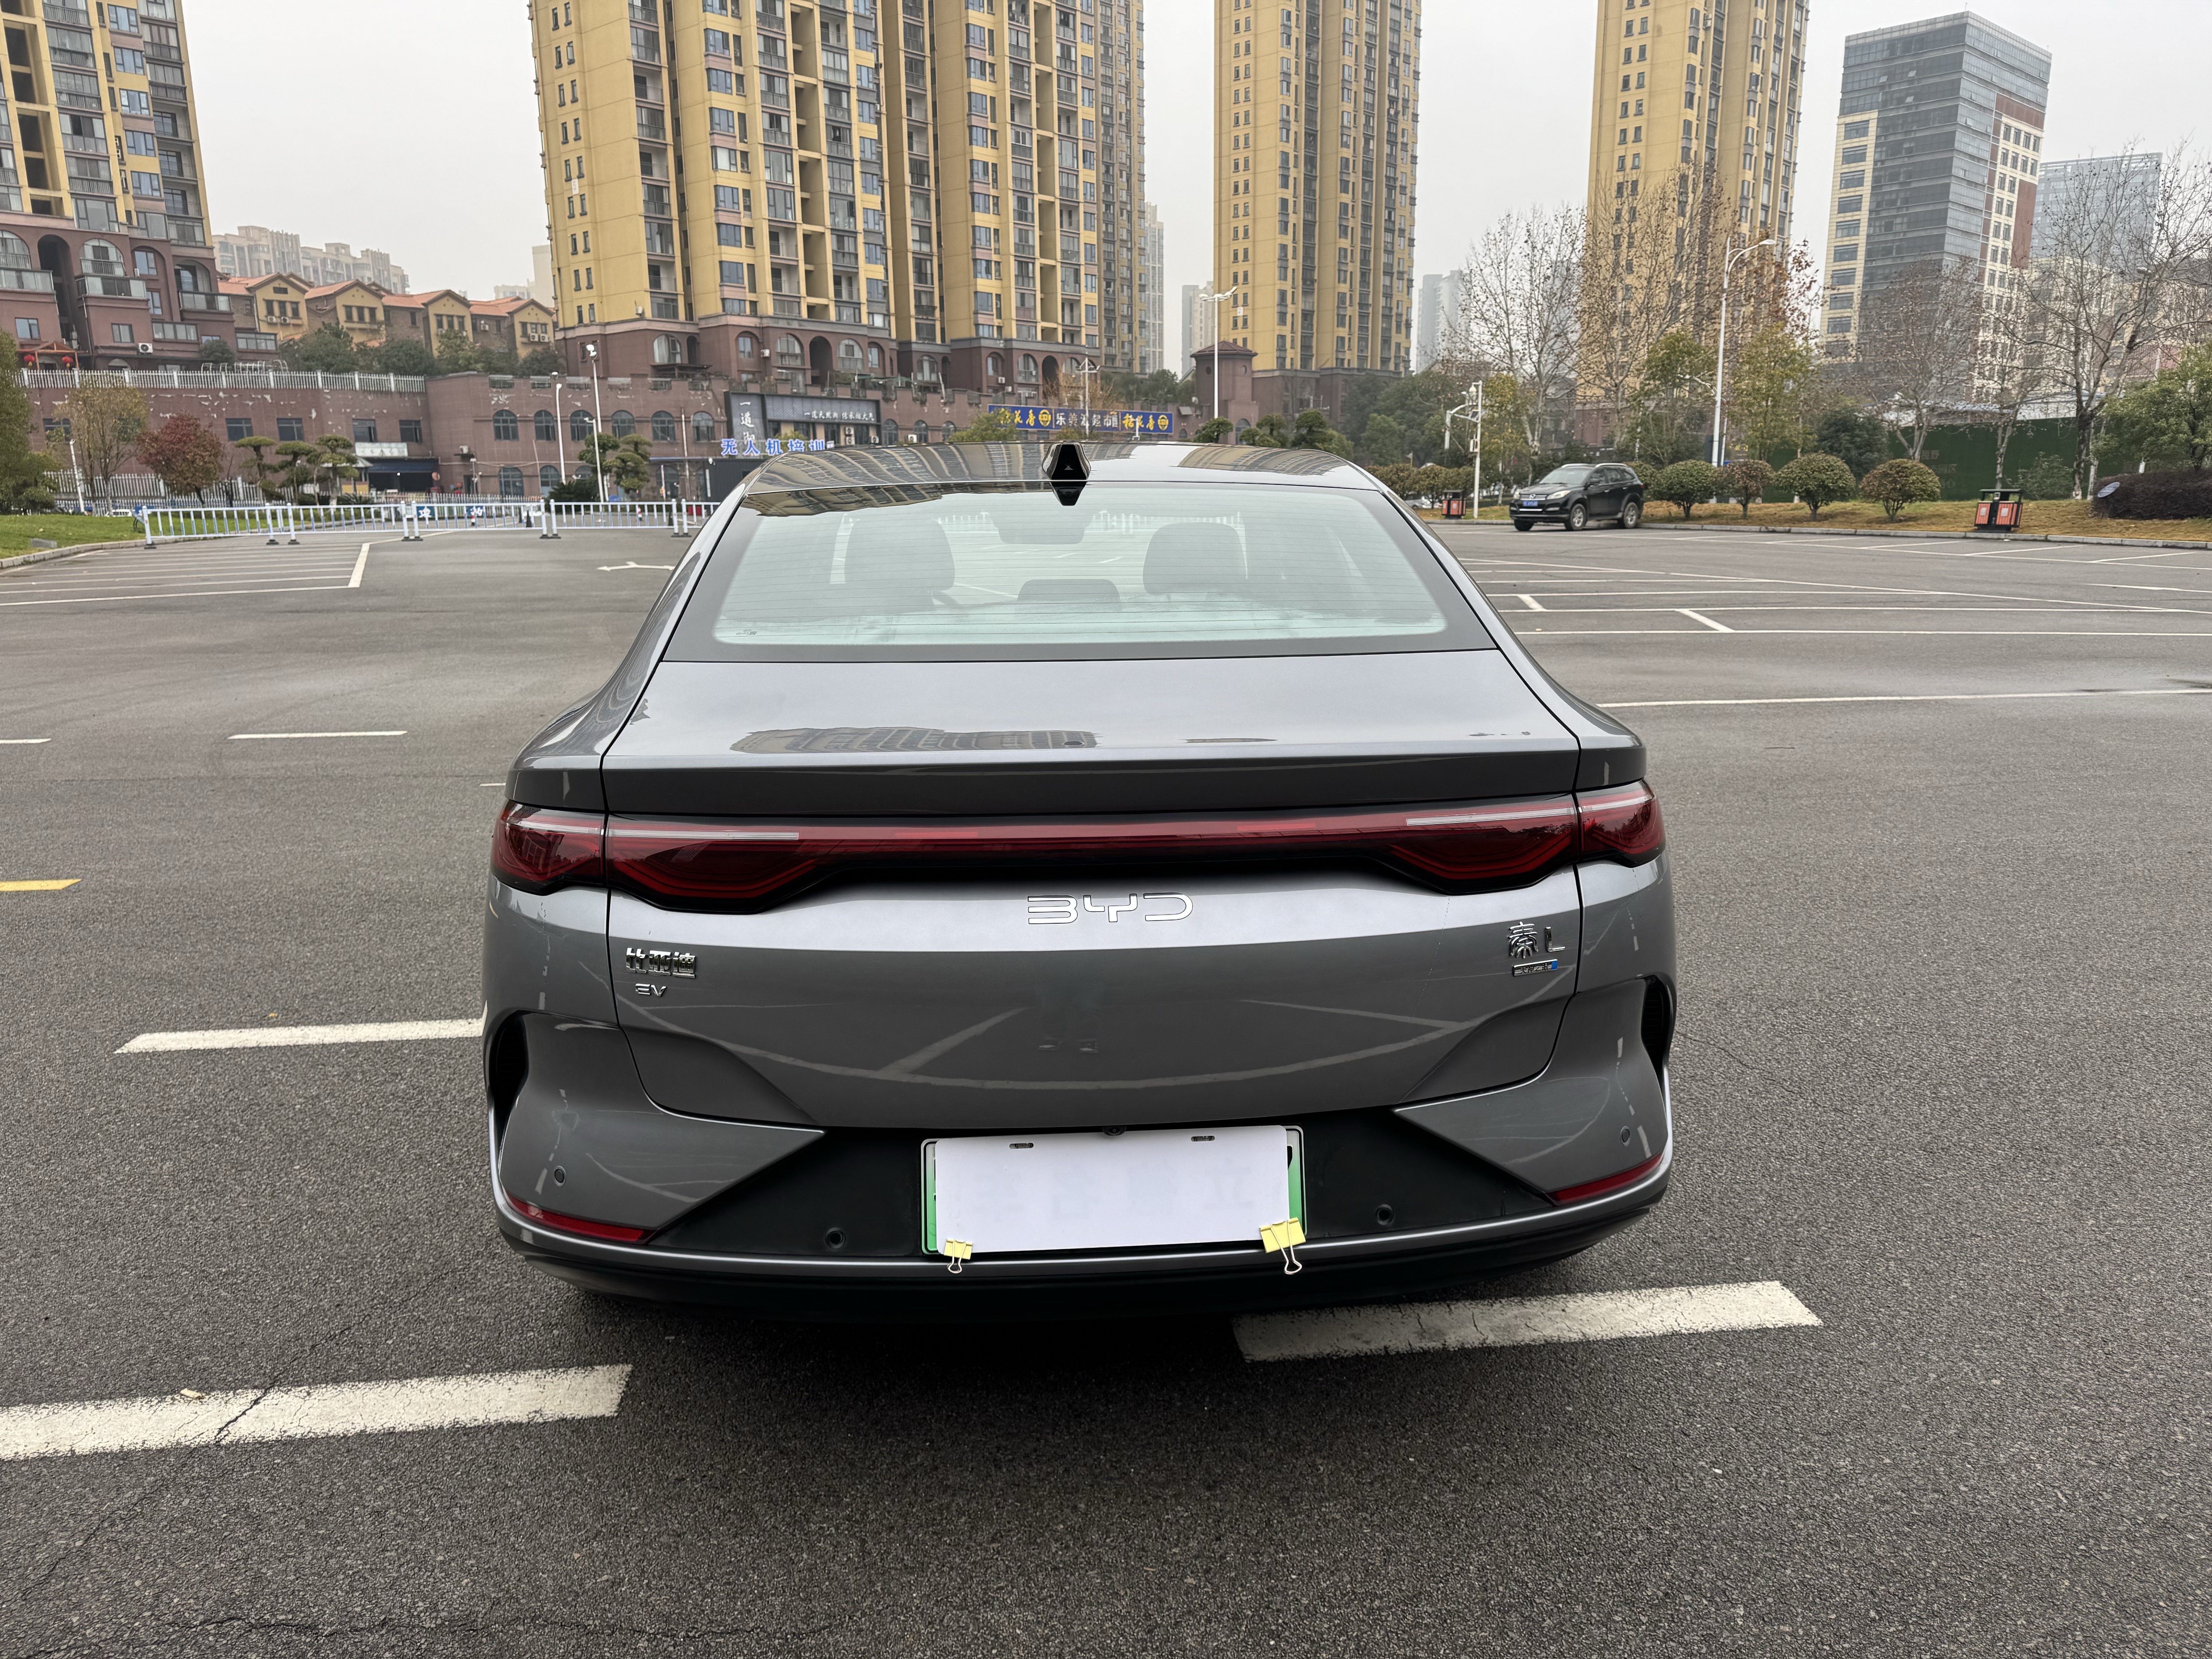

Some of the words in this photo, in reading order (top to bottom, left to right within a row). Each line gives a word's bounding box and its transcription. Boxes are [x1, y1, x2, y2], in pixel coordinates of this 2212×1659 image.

[721, 438, 825, 456] 无人机培训
[1027, 892, 1194, 924] BYD
[626, 947, 696, 978] 比亚迪
[1520, 963, 1549, 973] 天神之眼
[635, 983, 667, 997] EV
